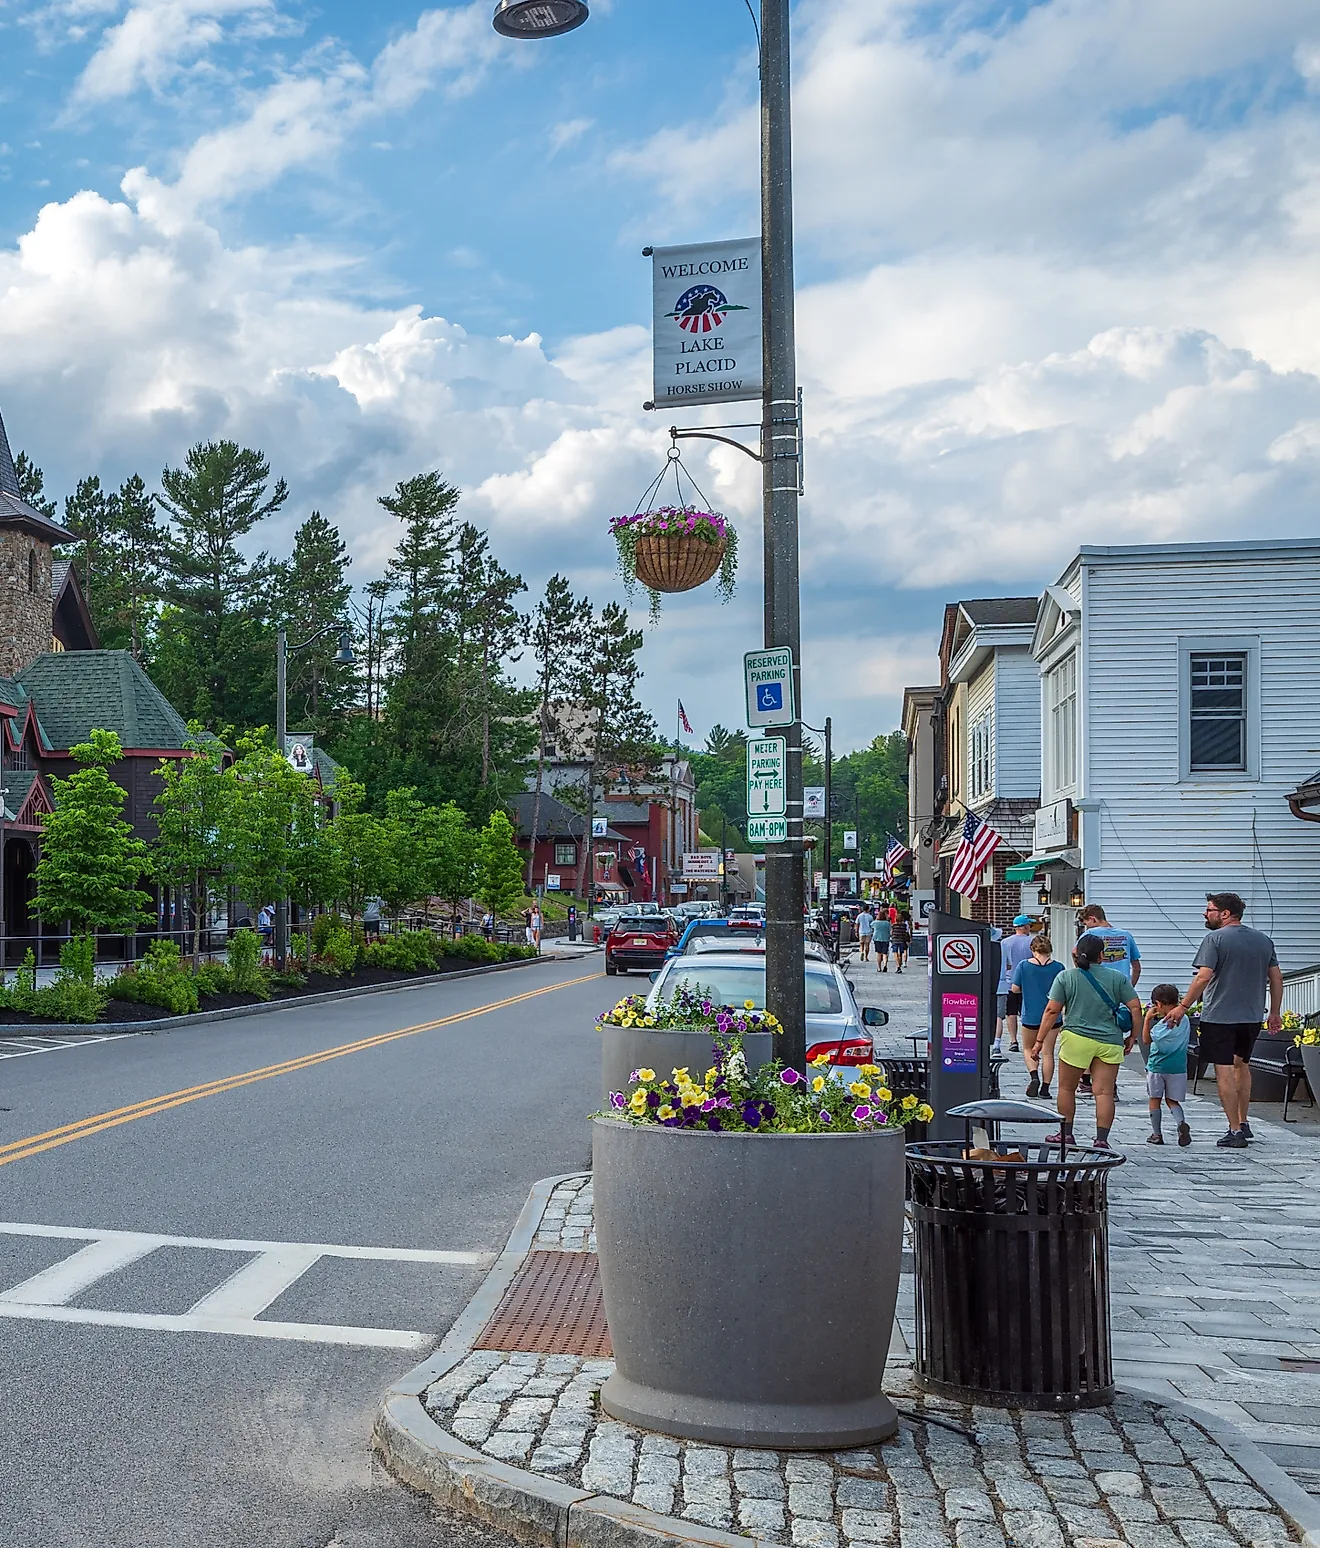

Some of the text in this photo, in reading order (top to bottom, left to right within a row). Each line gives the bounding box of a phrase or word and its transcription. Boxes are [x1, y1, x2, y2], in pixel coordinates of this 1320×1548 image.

[661, 257, 749, 278] WELCOME
[680, 337, 725, 354] LAKE
[675, 358, 737, 375] PLACID
[667, 380, 743, 395] HORSE SHOW
[747, 654, 788, 670] RESERVED
[750, 669, 786, 683] PARKING
[754, 743, 778, 754] METER
[751, 758, 780, 769] PARKING
[749, 778, 783, 790] PAY HERE
[749, 821, 785, 838] 8AM-8PM
